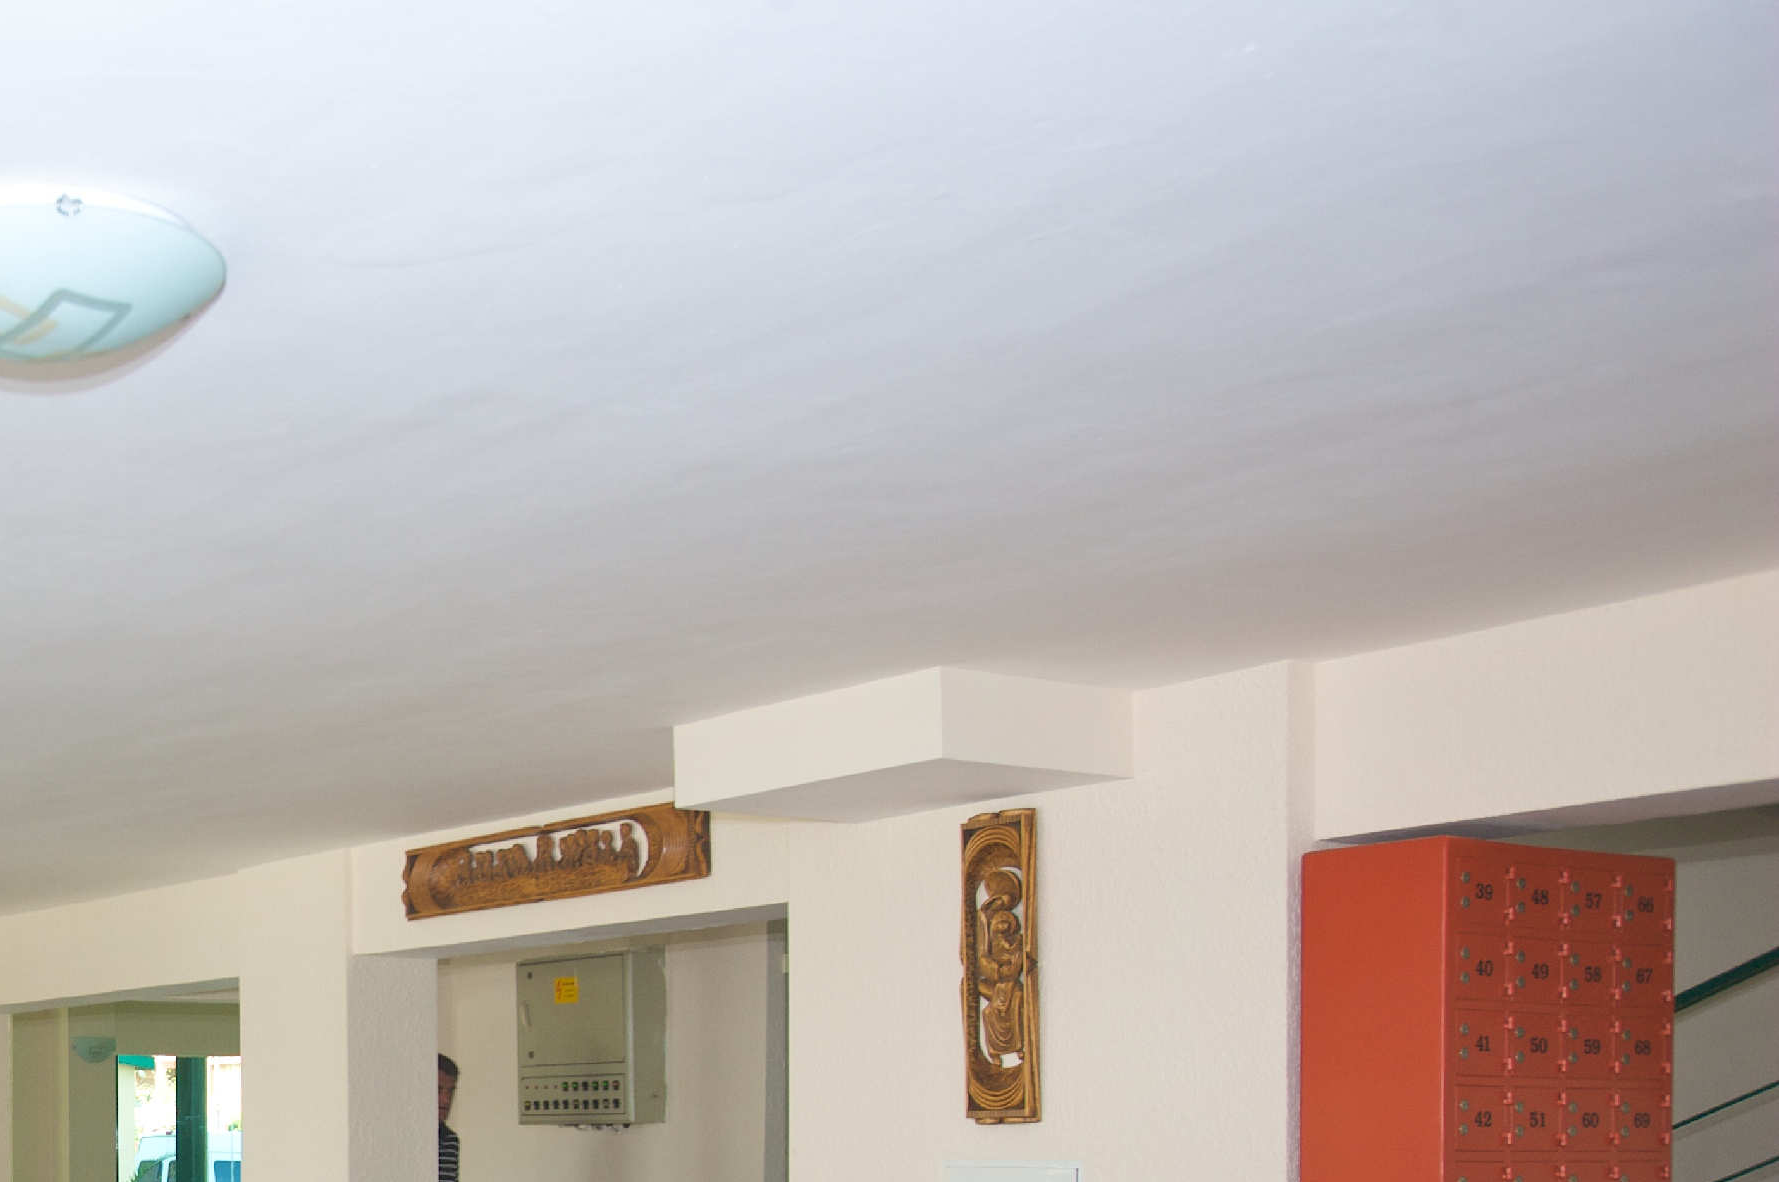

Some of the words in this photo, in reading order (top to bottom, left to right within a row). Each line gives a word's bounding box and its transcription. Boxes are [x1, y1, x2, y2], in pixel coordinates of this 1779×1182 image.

[1474, 882, 1494, 901] 39
[1531, 888, 1549, 906] 48
[1585, 891, 1603, 910] 57
[1637, 896, 1655, 914] 66
[1475, 959, 1494, 978] 40
[1531, 963, 1550, 980] 49
[1584, 965, 1602, 983] 58
[1635, 967, 1654, 985] 67
[1475, 1035, 1491, 1053] 41
[1530, 1036, 1549, 1054] 50
[1583, 1038, 1602, 1055] 59
[1634, 1039, 1652, 1056] 68
[1474, 1110, 1493, 1128] 42
[1529, 1110, 1546, 1128] 51
[1581, 1111, 1600, 1129] 60
[1633, 1112, 1652, 1129] 69
